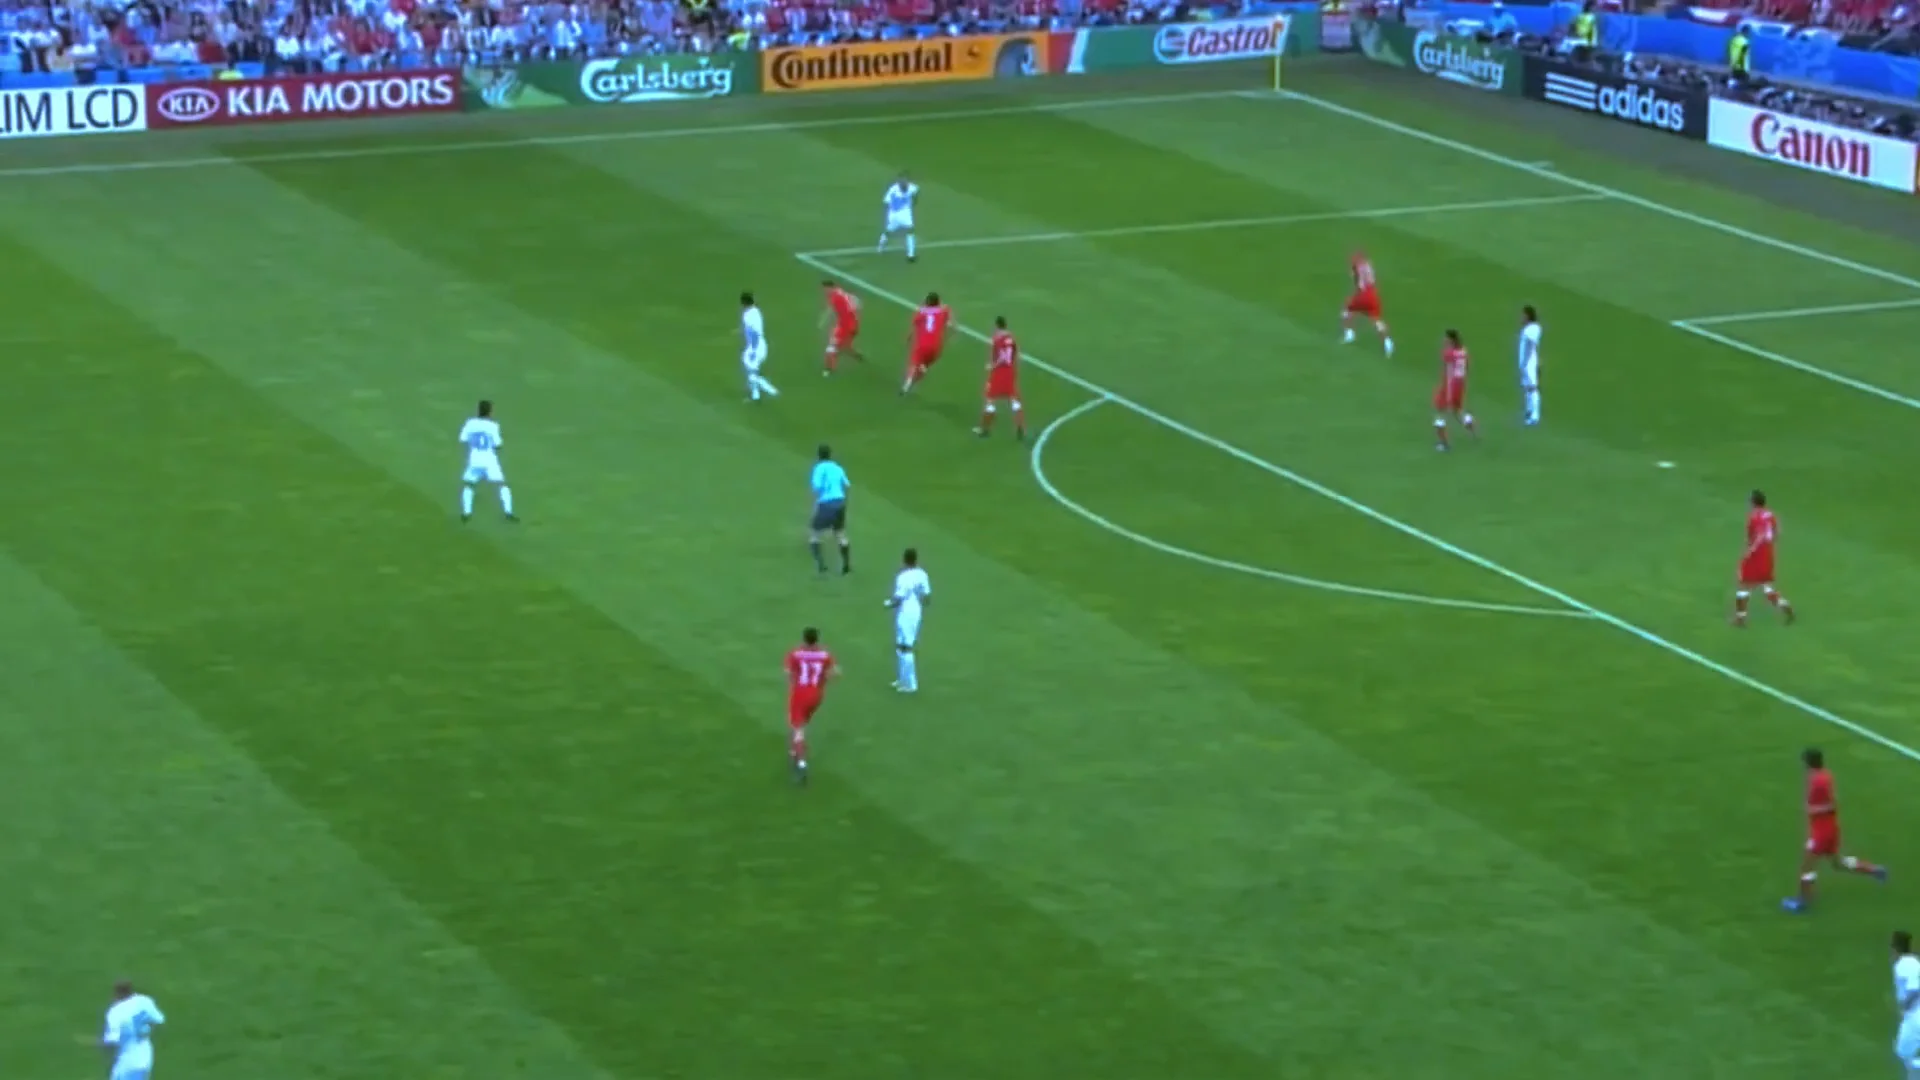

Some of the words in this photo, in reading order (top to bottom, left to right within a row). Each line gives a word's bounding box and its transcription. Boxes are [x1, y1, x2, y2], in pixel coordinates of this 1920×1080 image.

[1187, 20, 1284, 57] Castrol
[580, 56, 734, 102] Carlsberg
[770, 42, 953, 89] Continental
[0, 91, 52, 132] IM
[66, 88, 139, 129] LCD
[227, 84, 291, 116] KIA
[302, 74, 454, 112] MOTORS
[1598, 83, 1684, 131] adidas
[1751, 111, 1870, 177] Canon
[799, 660, 823, 687] 17
